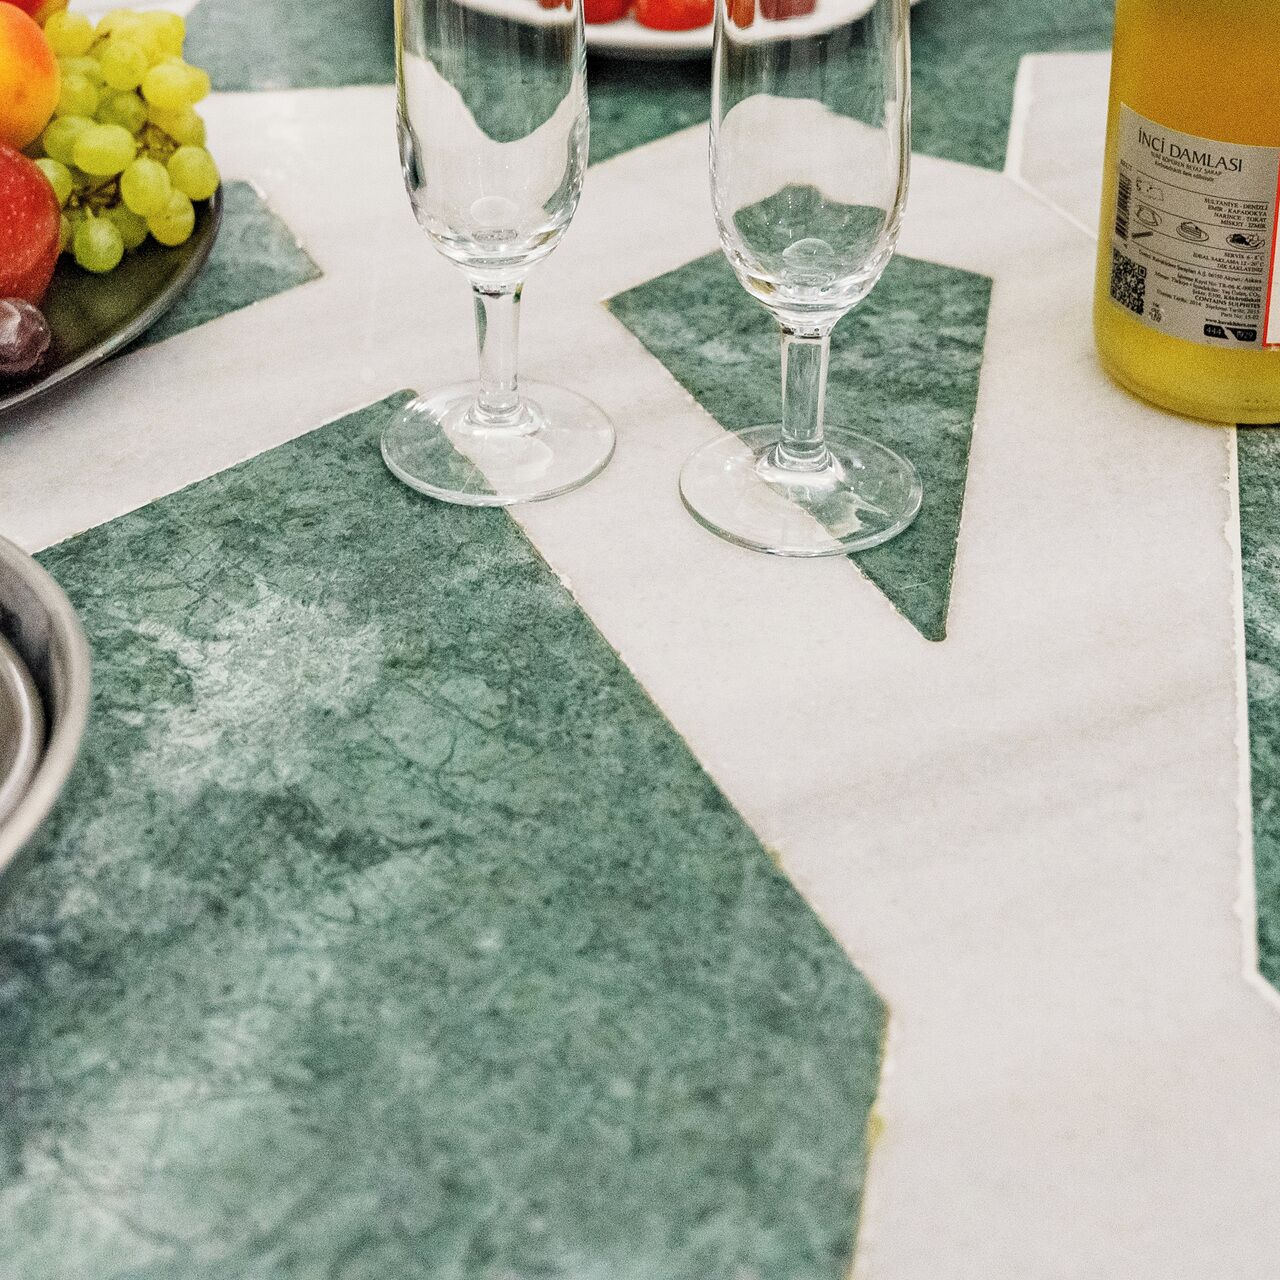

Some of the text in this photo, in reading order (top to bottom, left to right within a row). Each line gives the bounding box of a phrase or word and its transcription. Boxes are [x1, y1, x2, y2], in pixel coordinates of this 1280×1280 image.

[1138, 127, 1165, 153] İNCİ
[1169, 143, 1242, 172] DAMLASI
[1195, 295, 1227, 306] CONTAINS
